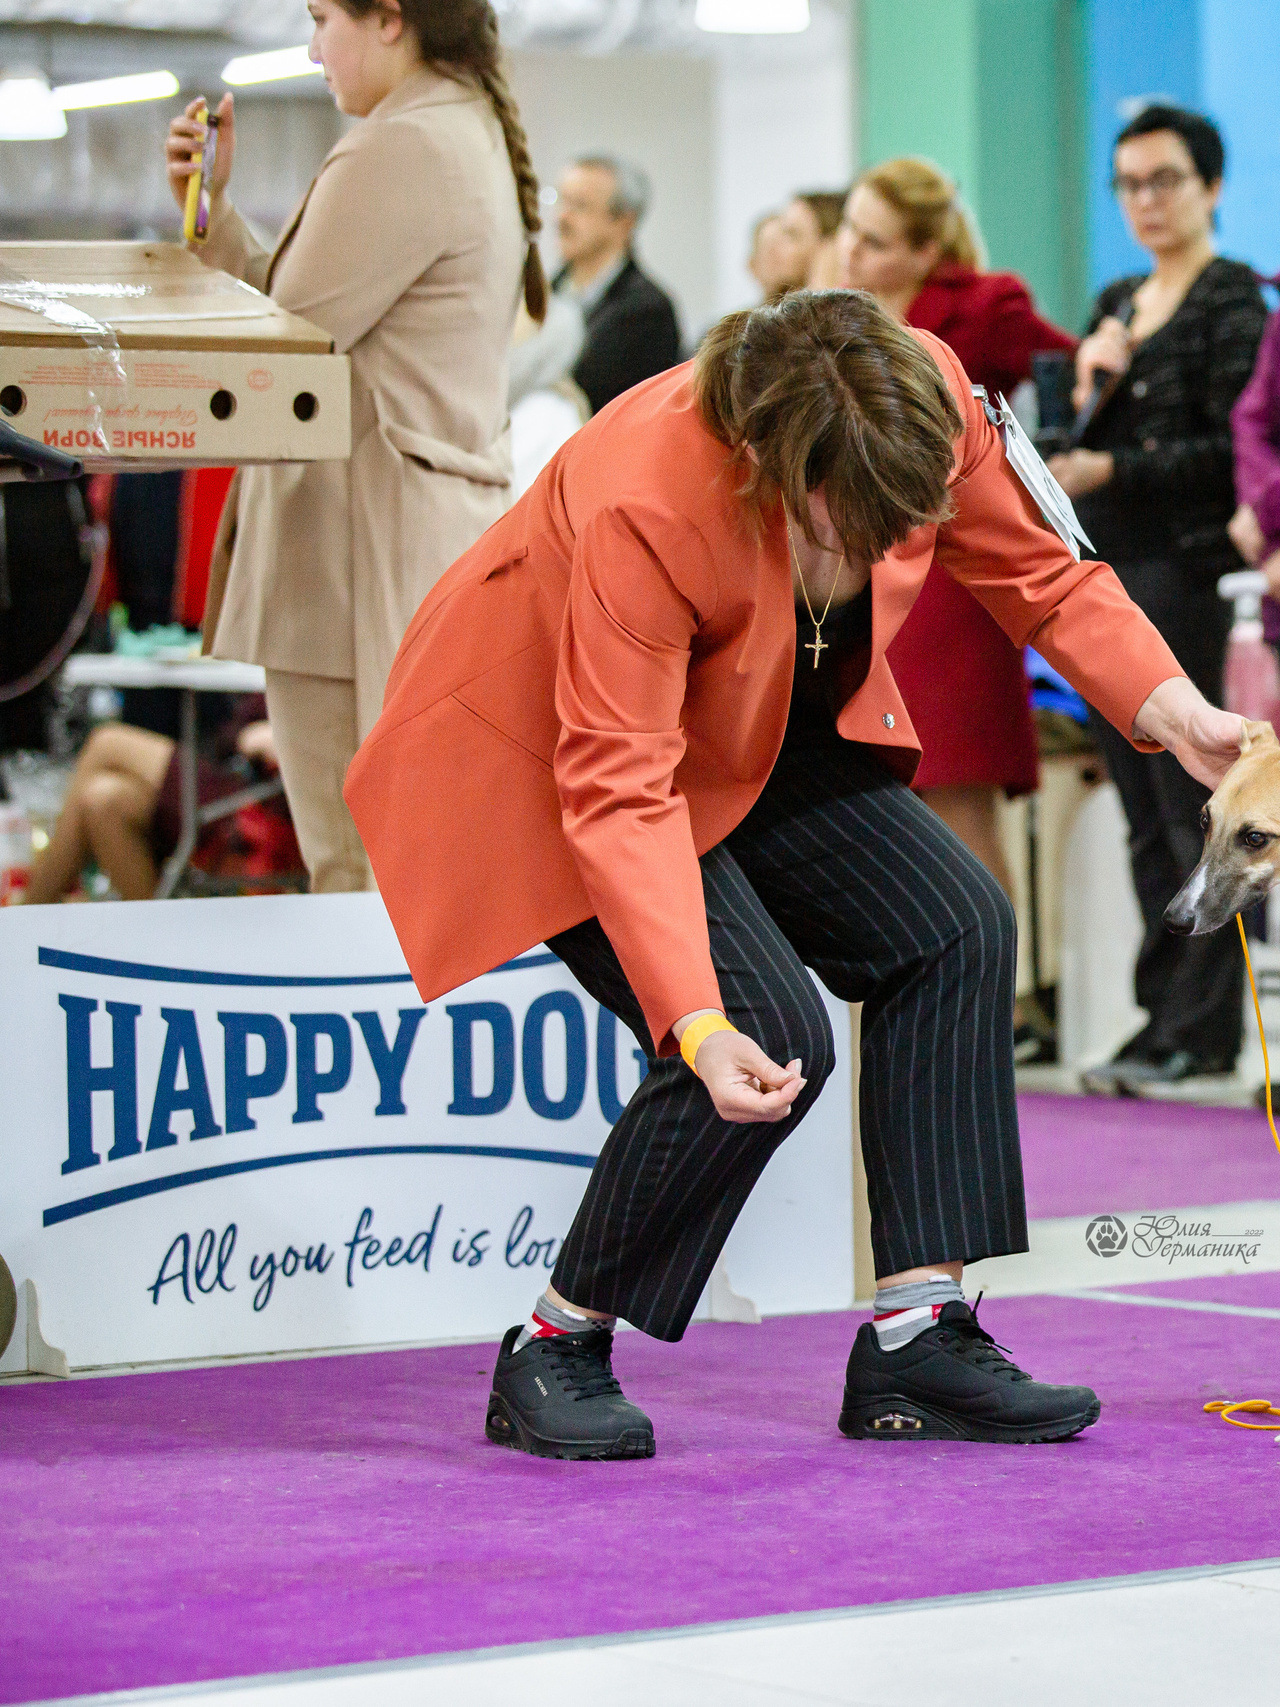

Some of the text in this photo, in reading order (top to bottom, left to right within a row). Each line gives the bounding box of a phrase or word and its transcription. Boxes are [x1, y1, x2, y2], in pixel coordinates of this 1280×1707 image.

[112, 430, 196, 449] ЯСНЫЕ
[58, 990, 649, 1176] HAPPY DOG
[147, 1204, 565, 1312] All you feed is lov
